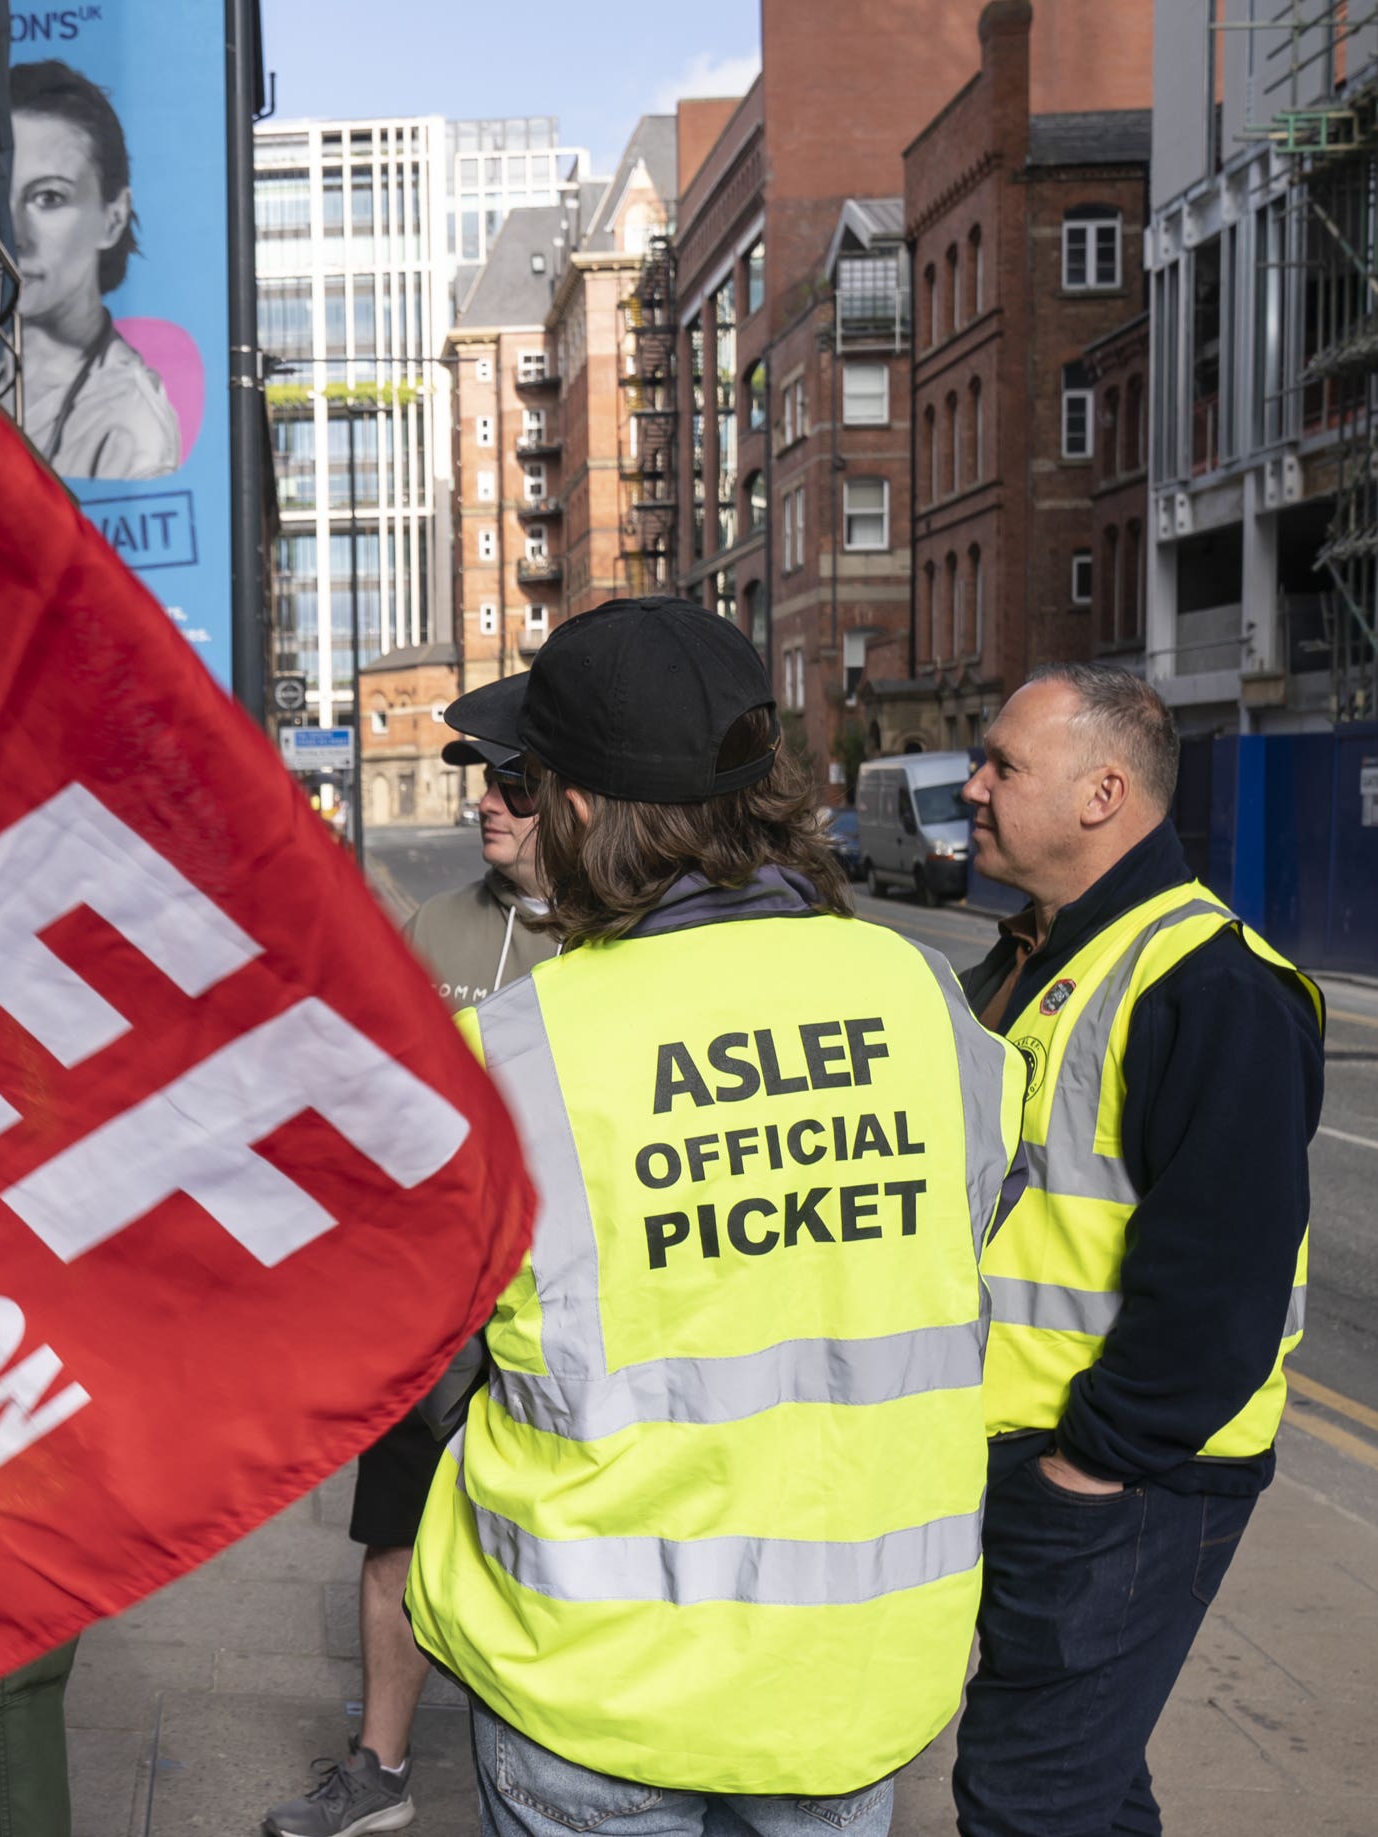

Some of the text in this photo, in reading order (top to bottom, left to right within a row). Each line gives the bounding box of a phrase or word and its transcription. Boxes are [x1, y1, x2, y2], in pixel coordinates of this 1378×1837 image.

[653, 1016, 890, 1115] ASLEF
[635, 1110, 926, 1190] OFFICIAL
[643, 1178, 928, 1270] PICKET
